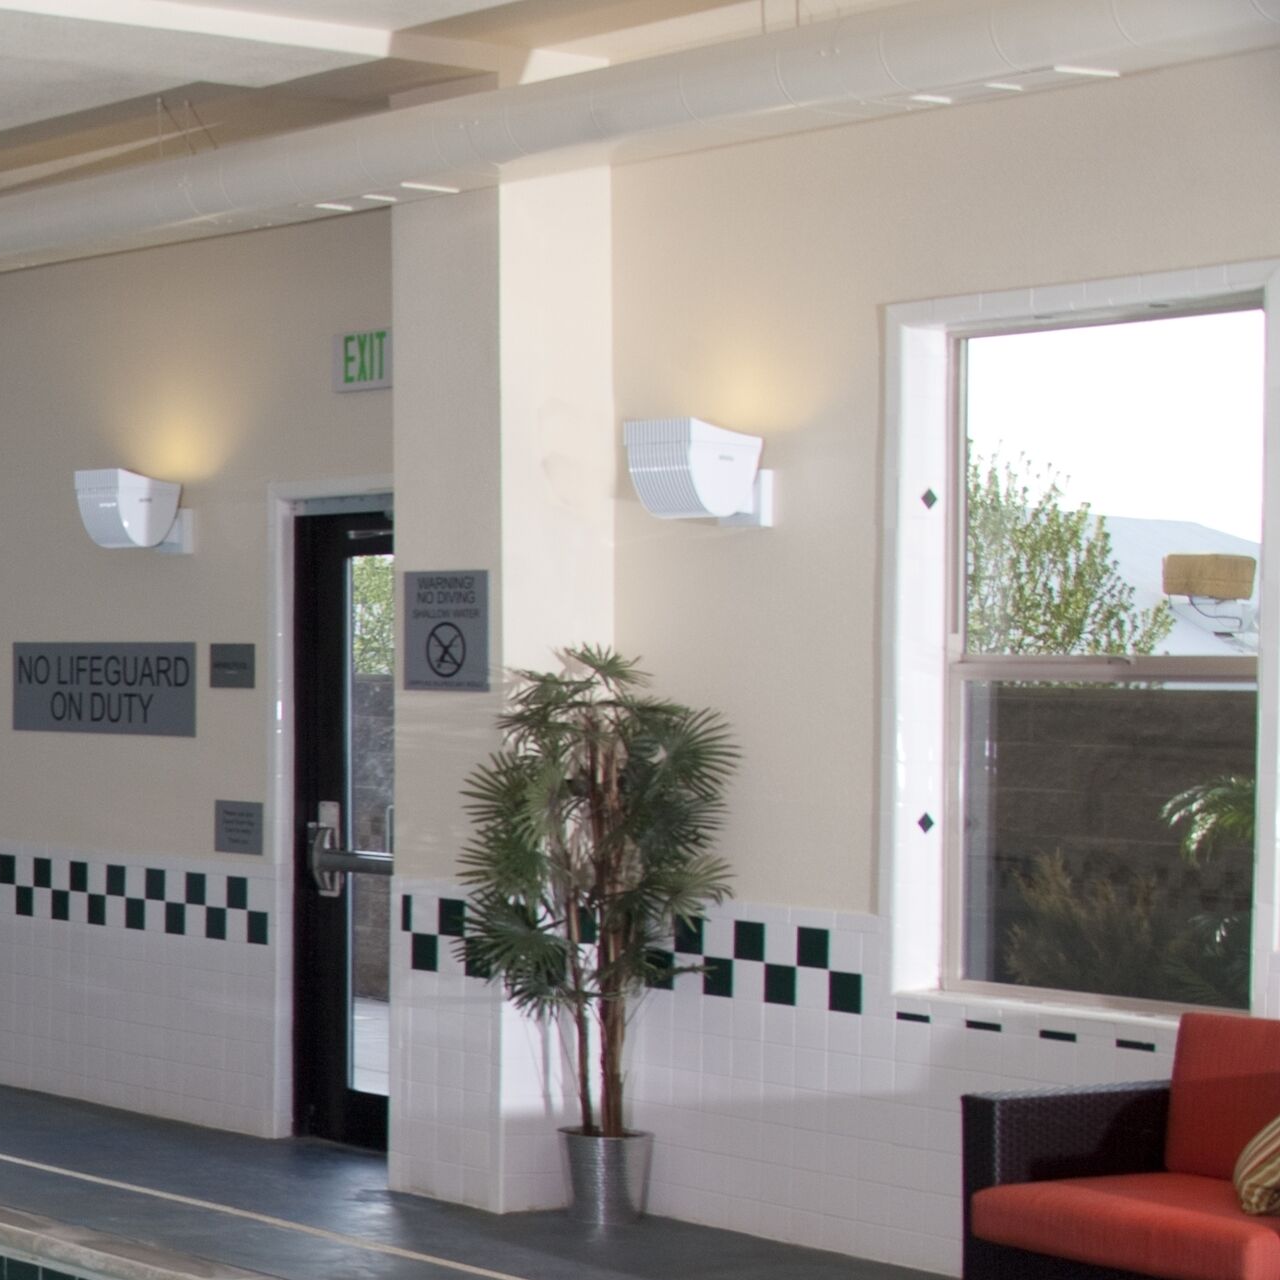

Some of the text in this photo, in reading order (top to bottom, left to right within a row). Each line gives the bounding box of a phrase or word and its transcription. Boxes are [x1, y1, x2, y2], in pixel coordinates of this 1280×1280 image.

[343, 331, 387, 383] EXIT
[417, 576, 475, 590] WARNING!
[417, 590, 476, 604] NO DIVING
[17, 655, 190, 687] NO LIFEGUARD
[50, 691, 155, 724] ON DUTY
